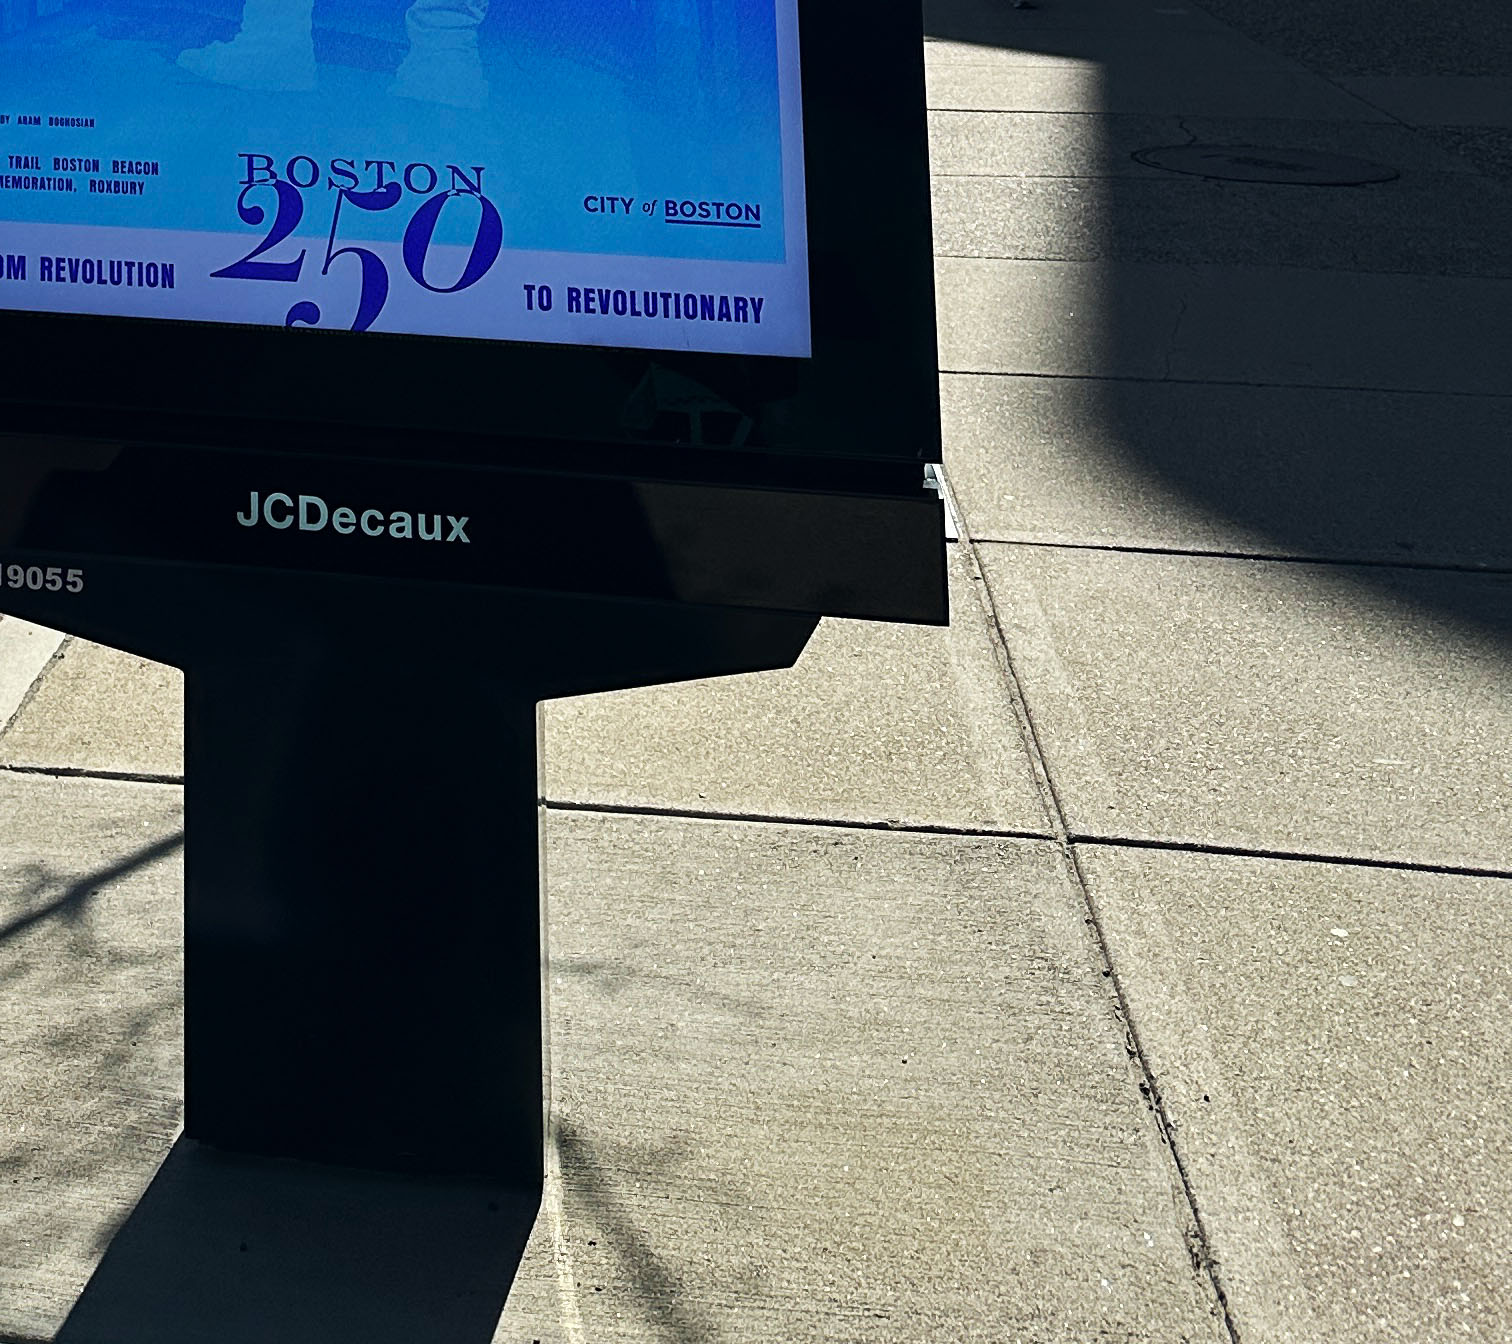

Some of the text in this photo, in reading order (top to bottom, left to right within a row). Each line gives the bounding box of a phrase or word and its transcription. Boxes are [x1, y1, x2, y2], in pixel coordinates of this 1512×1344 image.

[0, 114, 10, 125] BY
[7, 155, 41, 171] TRAIL
[53, 157, 100, 173] BOSTON
[111, 159, 159, 176] BEACON
[237, 153, 486, 197] BOSTON
[89, 179, 145, 196] ROXBURY
[583, 195, 761, 221] CITY of BOSTON
[210, 178, 504, 332] 250
[39, 256, 175, 289] REVOLUTION
[523, 284, 765, 324] TO REVOLUTIONARY
[236, 491, 472, 544] JCDecaux
